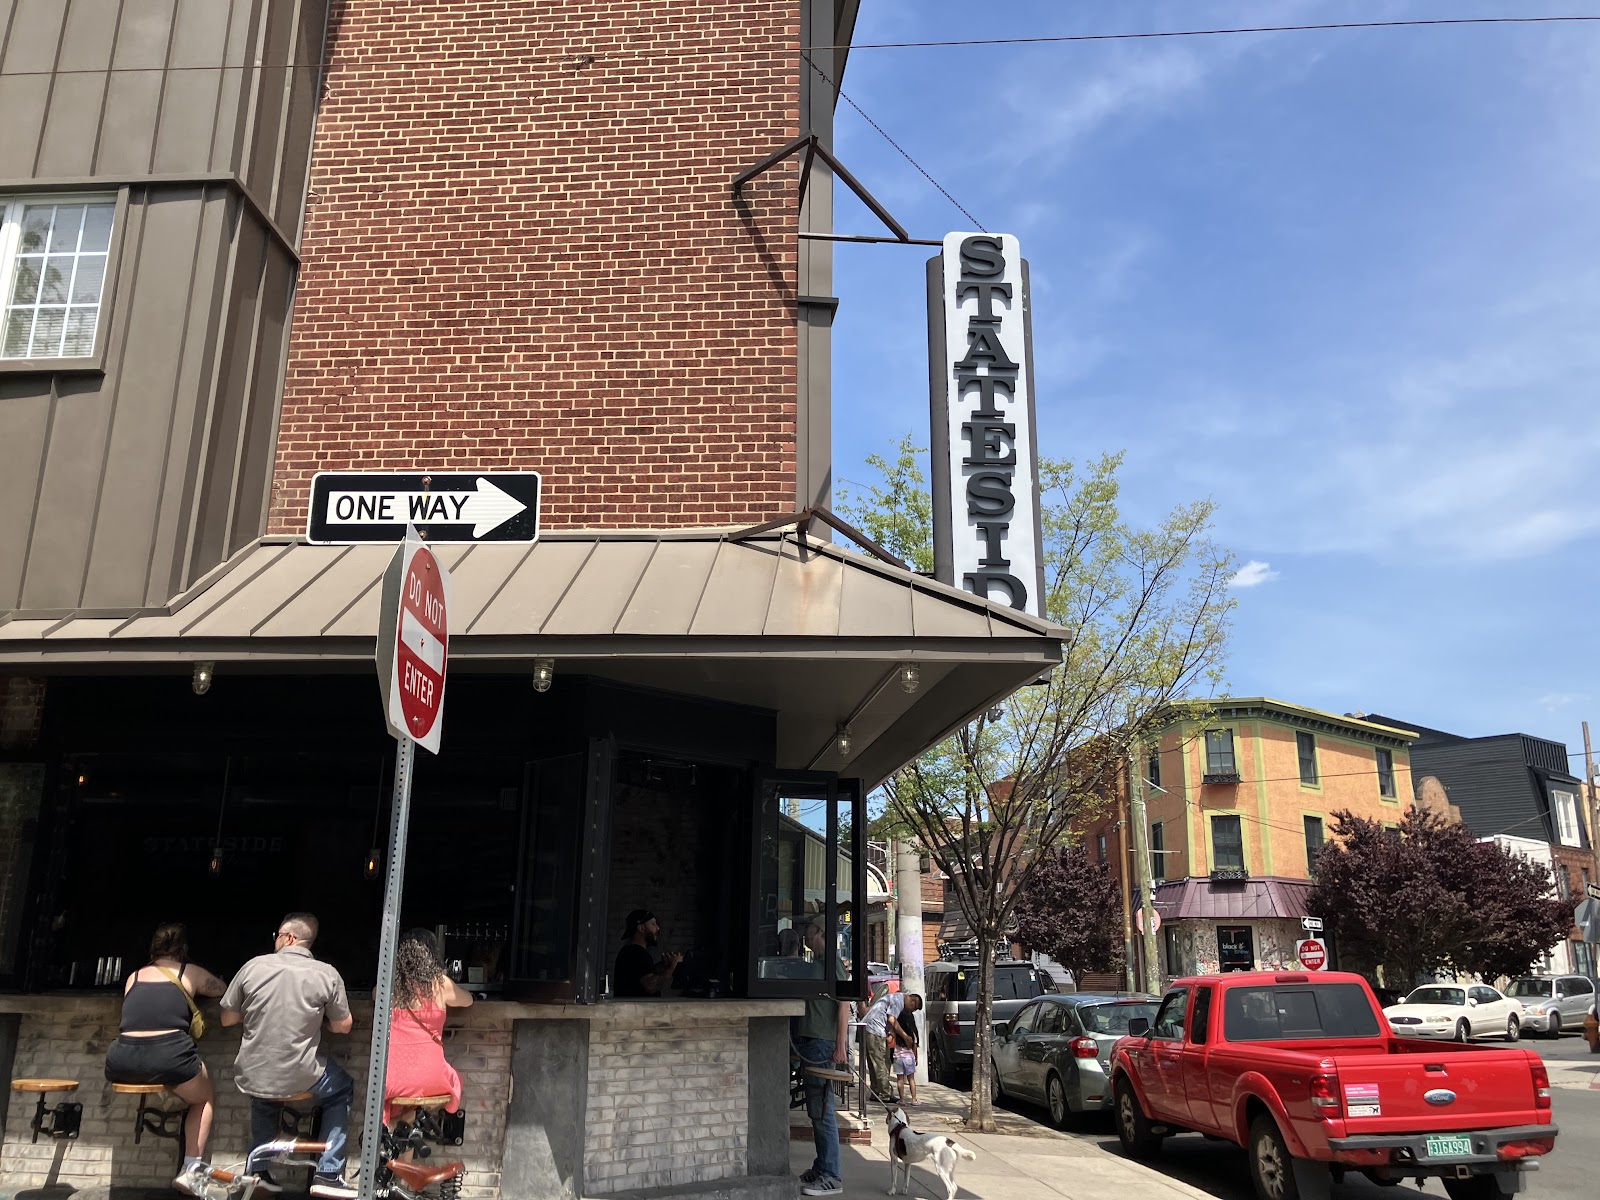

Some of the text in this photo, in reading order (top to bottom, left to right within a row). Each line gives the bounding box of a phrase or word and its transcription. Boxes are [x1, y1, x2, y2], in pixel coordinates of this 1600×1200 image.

[336, 495, 470, 520] ONE WAY
[408, 571, 444, 630] DO NOT
[404, 660, 434, 709] ENTER
